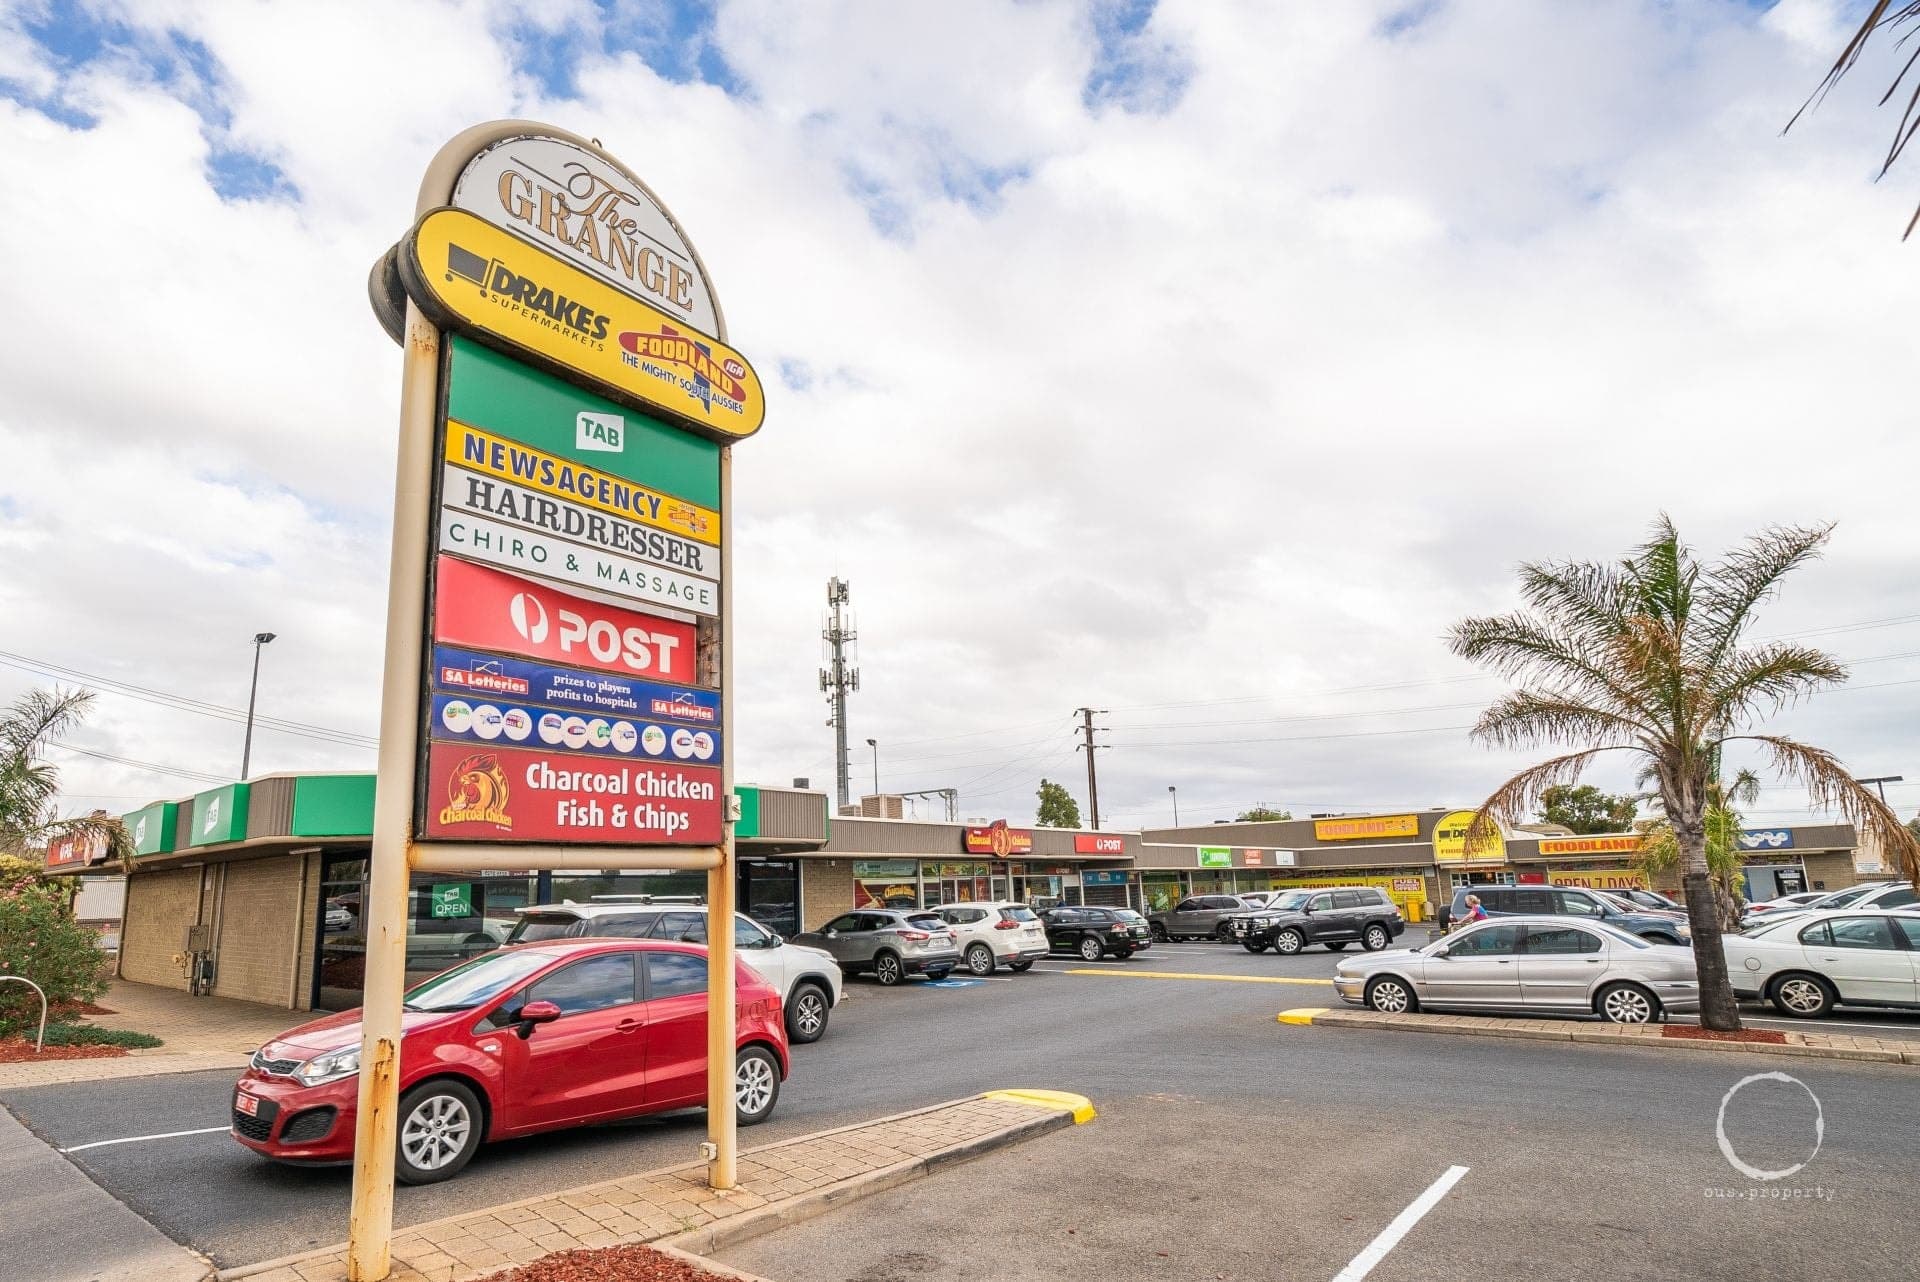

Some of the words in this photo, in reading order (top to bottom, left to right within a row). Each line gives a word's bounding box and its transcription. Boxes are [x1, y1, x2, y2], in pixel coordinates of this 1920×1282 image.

[556, 161, 640, 235] The
[498, 168, 694, 313] GRANGE
[491, 267, 610, 341] DRAKES
[491, 294, 605, 352] SUPERMARKETS
[622, 351, 639, 369] THE
[641, 361, 677, 385] MIGHTY
[679, 378, 710, 400] SOUTH
[711, 393, 743, 415] AUSSIES
[636, 336, 733, 394] FOODLAND
[726, 361, 745, 377] IGA
[581, 417, 619, 447] TAB
[464, 432, 662, 520] NEWSAGENCY
[465, 476, 704, 572] HAIRDRESSER
[449, 523, 548, 563] CHIRO
[566, 554, 579, 572] &
[597, 561, 709, 605] MASSAGE
[559, 609, 680, 673] POST
[445, 670, 463, 683] SA
[468, 673, 526, 692] Lotteries
[546, 688, 581, 700] profits
[583, 693, 594, 703] to
[595, 692, 638, 709] hospitals
[553, 674, 584, 687] prizes
[586, 679, 597, 689] to
[598, 680, 631, 695] players
[654, 701, 667, 713] SA
[670, 703, 712, 719] Lotteries
[526, 760, 629, 795] Charcoal
[634, 767, 714, 801] Chicken
[440, 806, 485, 825] Charcoal
[557, 798, 604, 828] Fish
[610, 803, 628, 828] &
[634, 804, 690, 836] Chips
[1103, 839, 1121, 851] POST
[1543, 839, 1640, 852] FOODLAND
[1555, 877, 1591, 889] OPEN
[1594, 878, 1603, 888] 7
[1607, 876, 1645, 889] DAYS
[435, 903, 468, 915] OPEN
